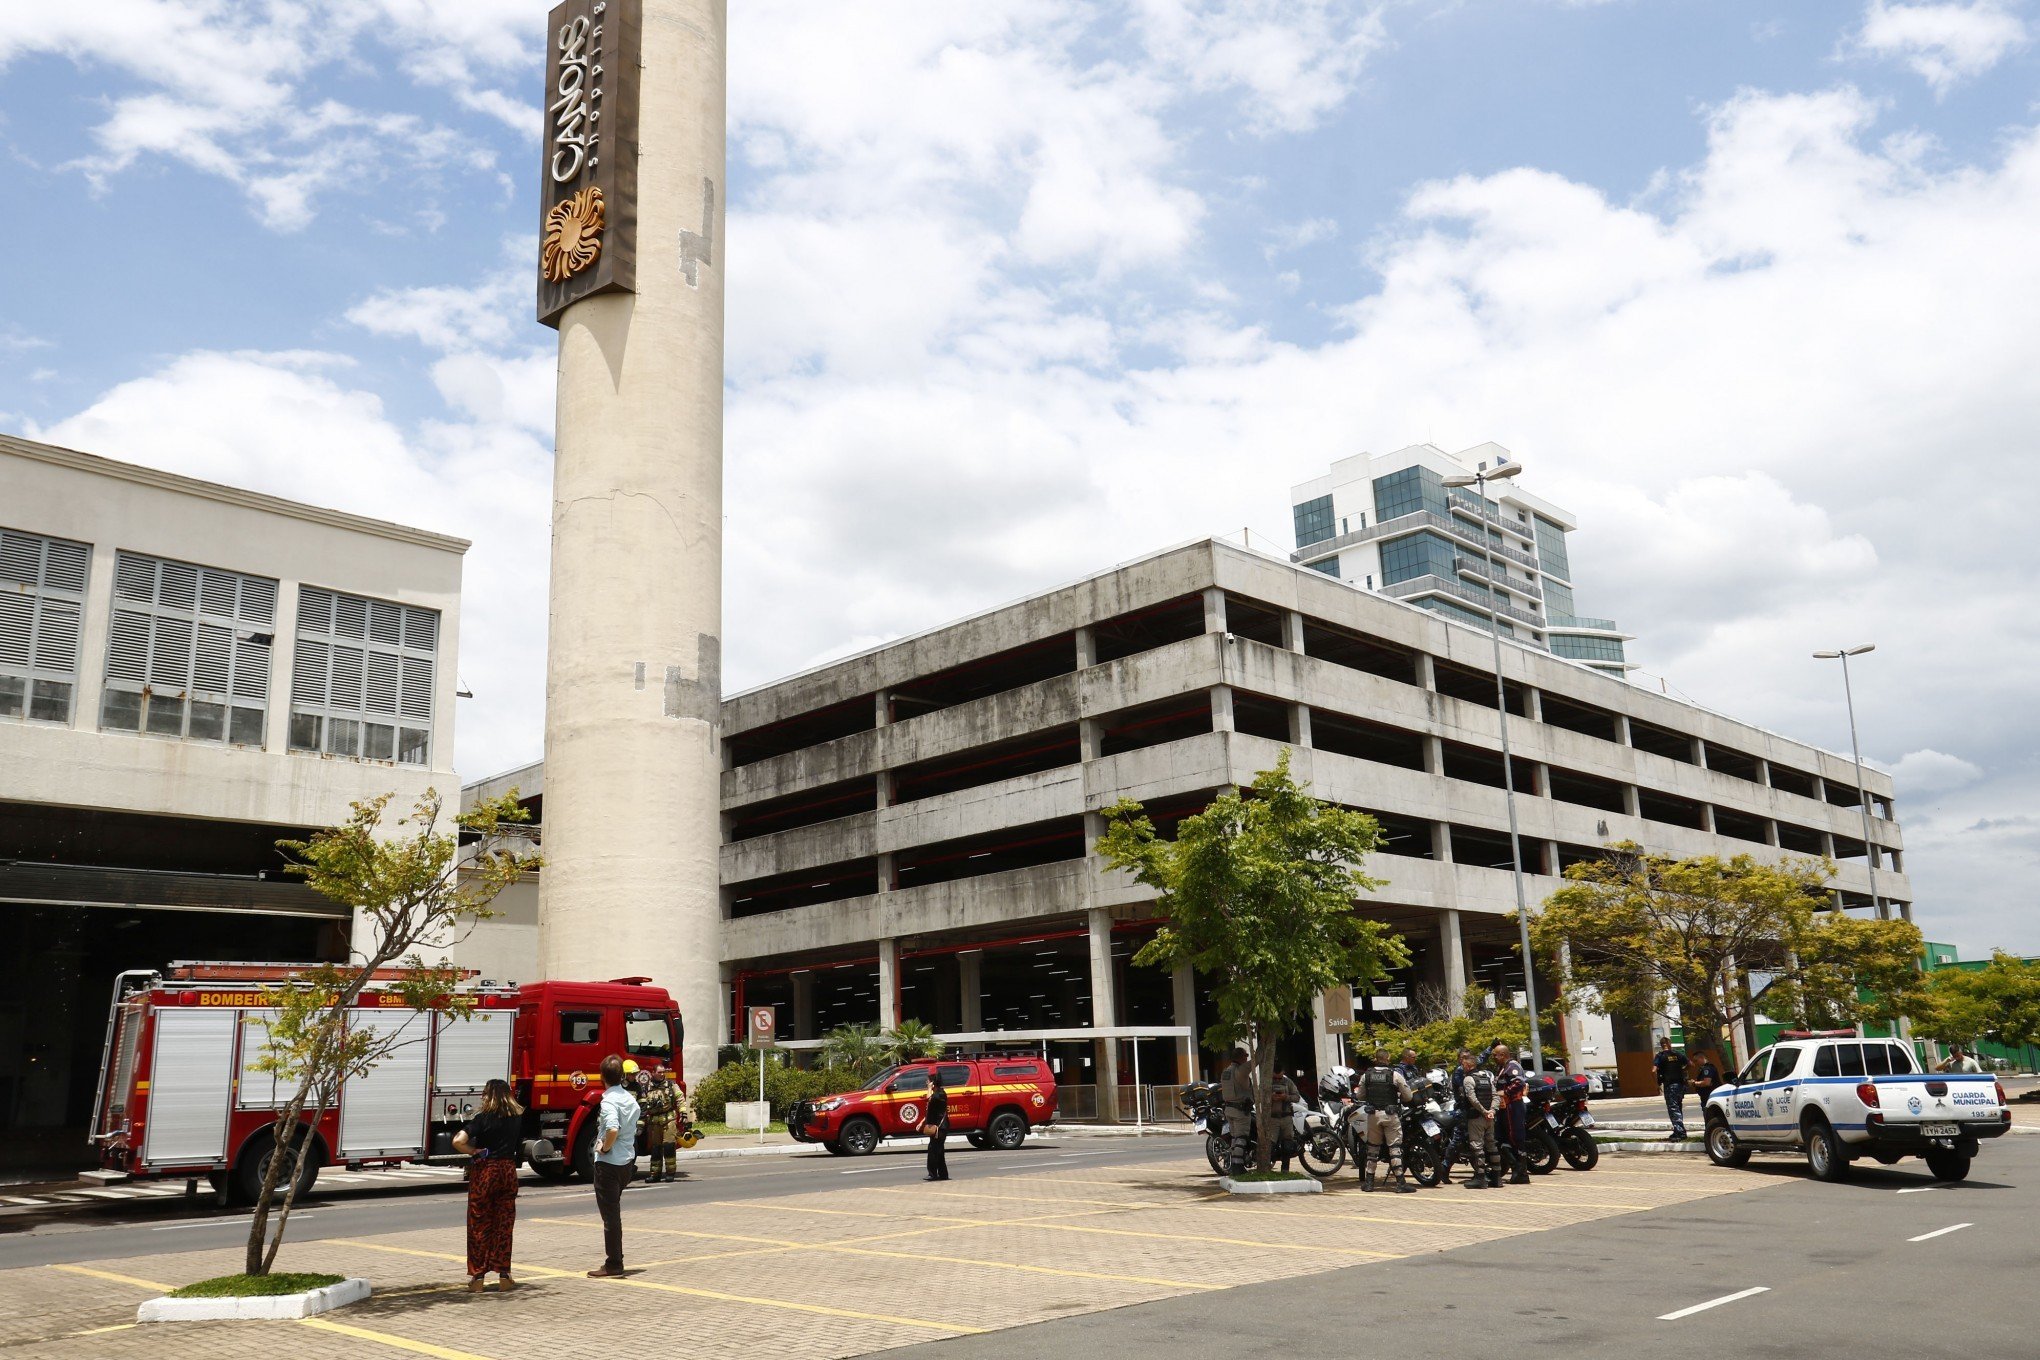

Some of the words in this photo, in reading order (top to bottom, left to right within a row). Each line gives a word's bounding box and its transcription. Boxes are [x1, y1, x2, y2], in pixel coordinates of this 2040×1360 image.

[586, 1, 606, 167] shopping
[549, 15, 590, 184] CANOAS
[200, 993, 268, 1006] BOMBEIR
[572, 1076, 587, 1085] 193
[1734, 1101, 1755, 1109] GUARDA
[1953, 1098, 1996, 1106] MUNICIPAL
[1735, 1109, 1762, 1118] MUNICIPAL
